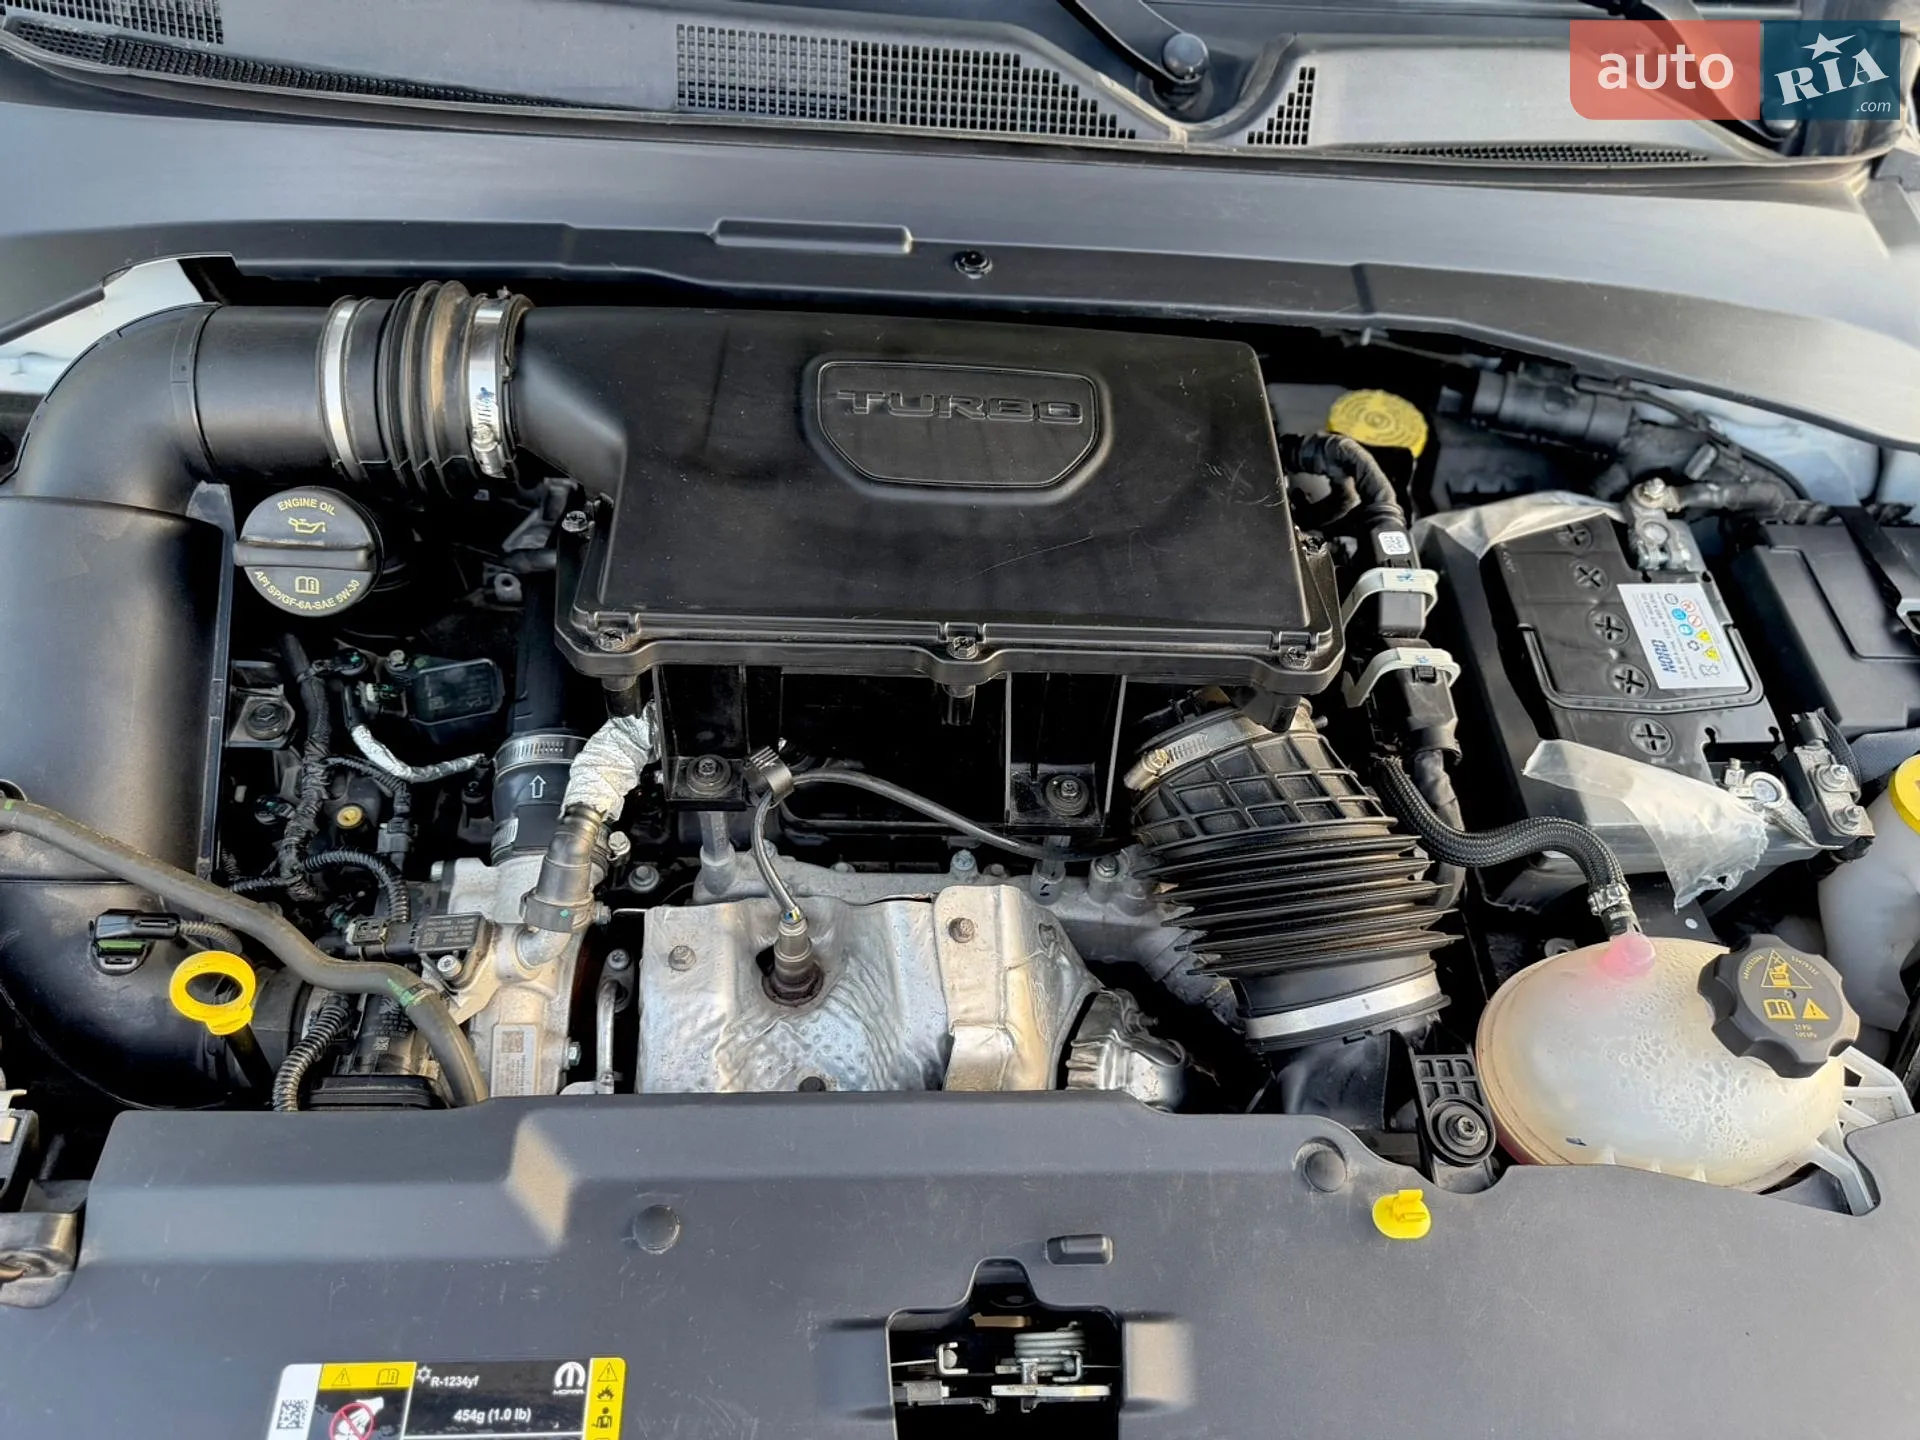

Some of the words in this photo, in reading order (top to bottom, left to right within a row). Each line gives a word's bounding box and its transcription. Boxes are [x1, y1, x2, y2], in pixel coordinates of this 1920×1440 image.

[836, 390, 1083, 424] TURBO
[277, 497, 318, 511] ENGINE
[319, 501, 336, 516] OIL
[253, 571, 269, 588] API
[335, 579, 361, 603] 5W-30
[1651, 639, 1678, 673] NORD
[430, 1375, 479, 1389] R-1234yf
[453, 1409, 486, 1424] 454g
[487, 1408, 512, 1423] (1.0
[514, 1407, 532, 1422] lb)
